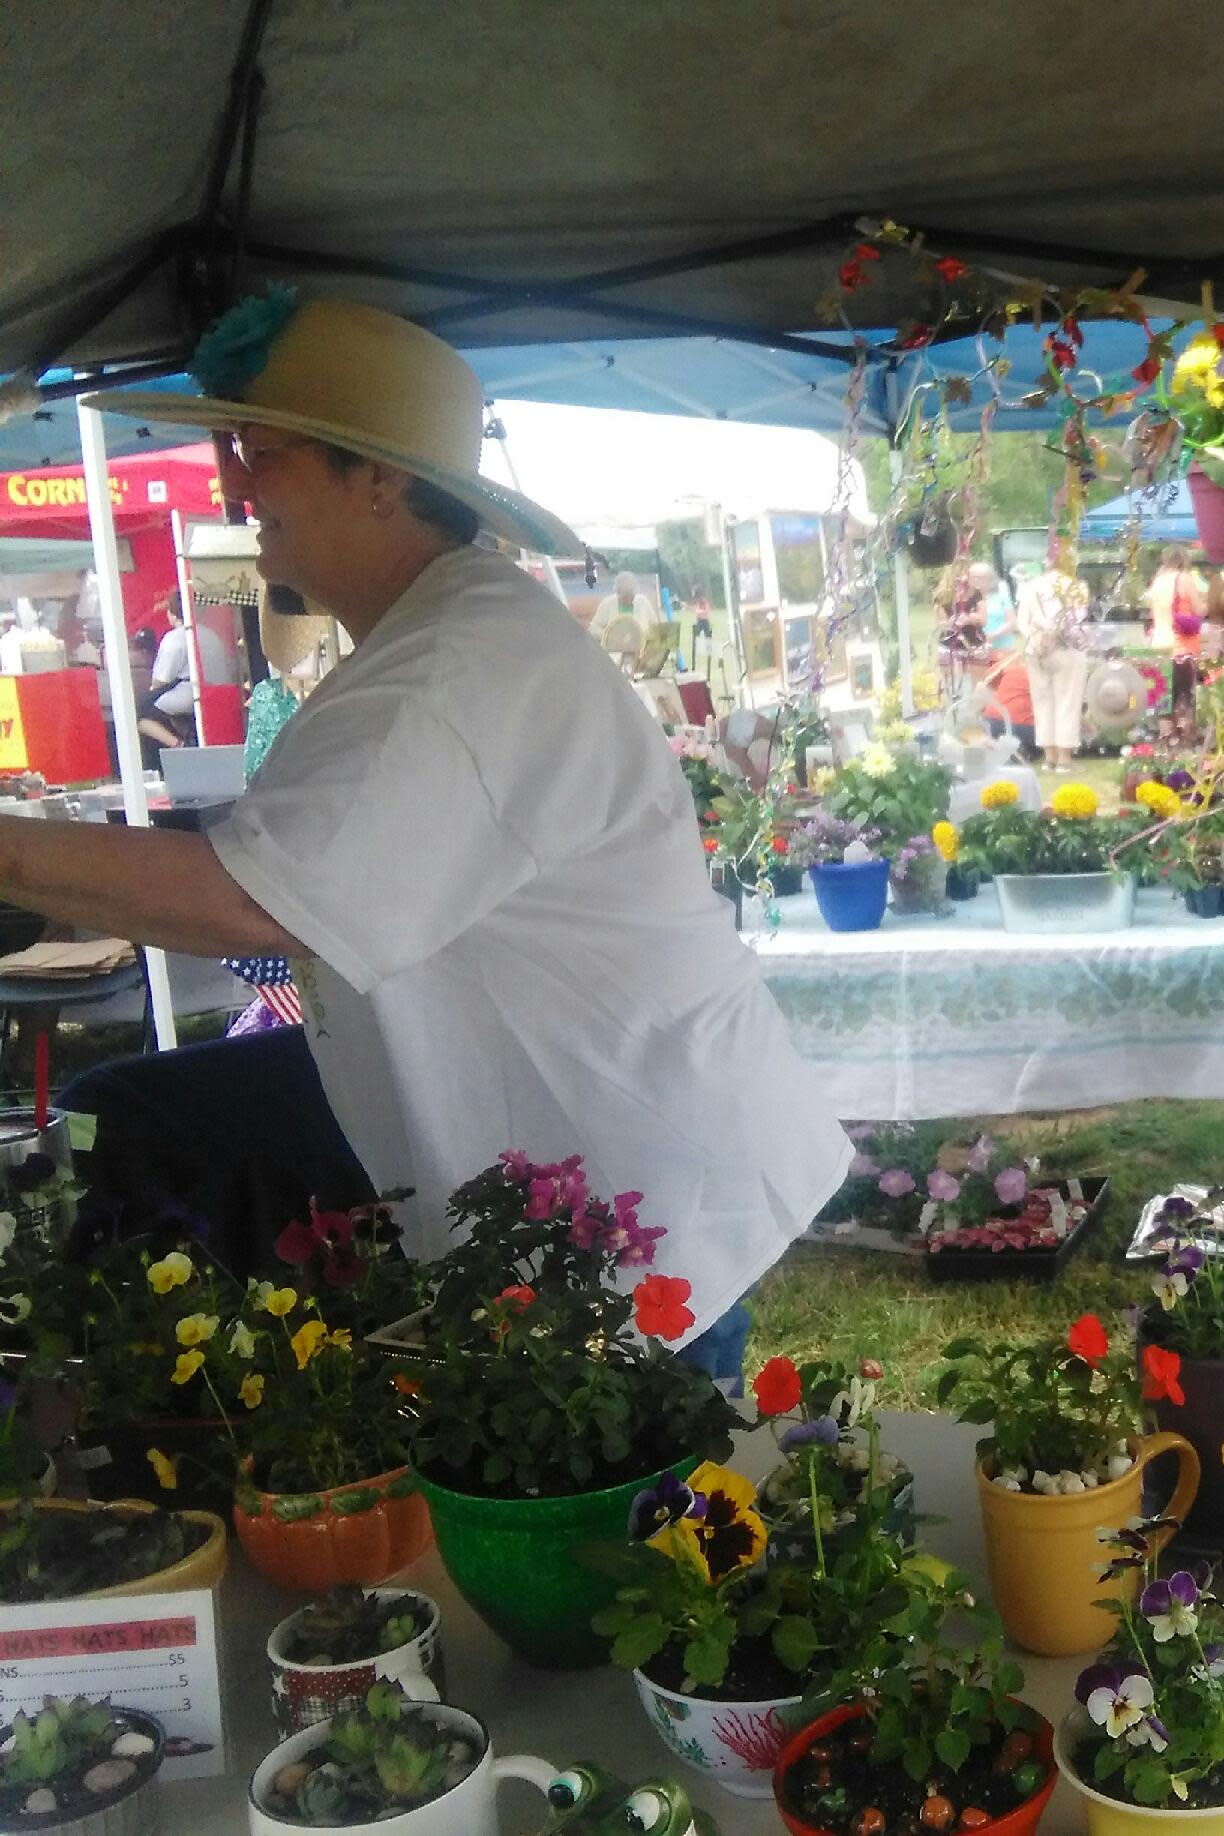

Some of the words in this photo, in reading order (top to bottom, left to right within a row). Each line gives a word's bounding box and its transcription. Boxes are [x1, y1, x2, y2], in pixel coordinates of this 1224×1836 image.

[72, 1627, 128, 1649] HATS
[179, 1674, 189, 1688] 5
[182, 1697, 192, 1711] 3
